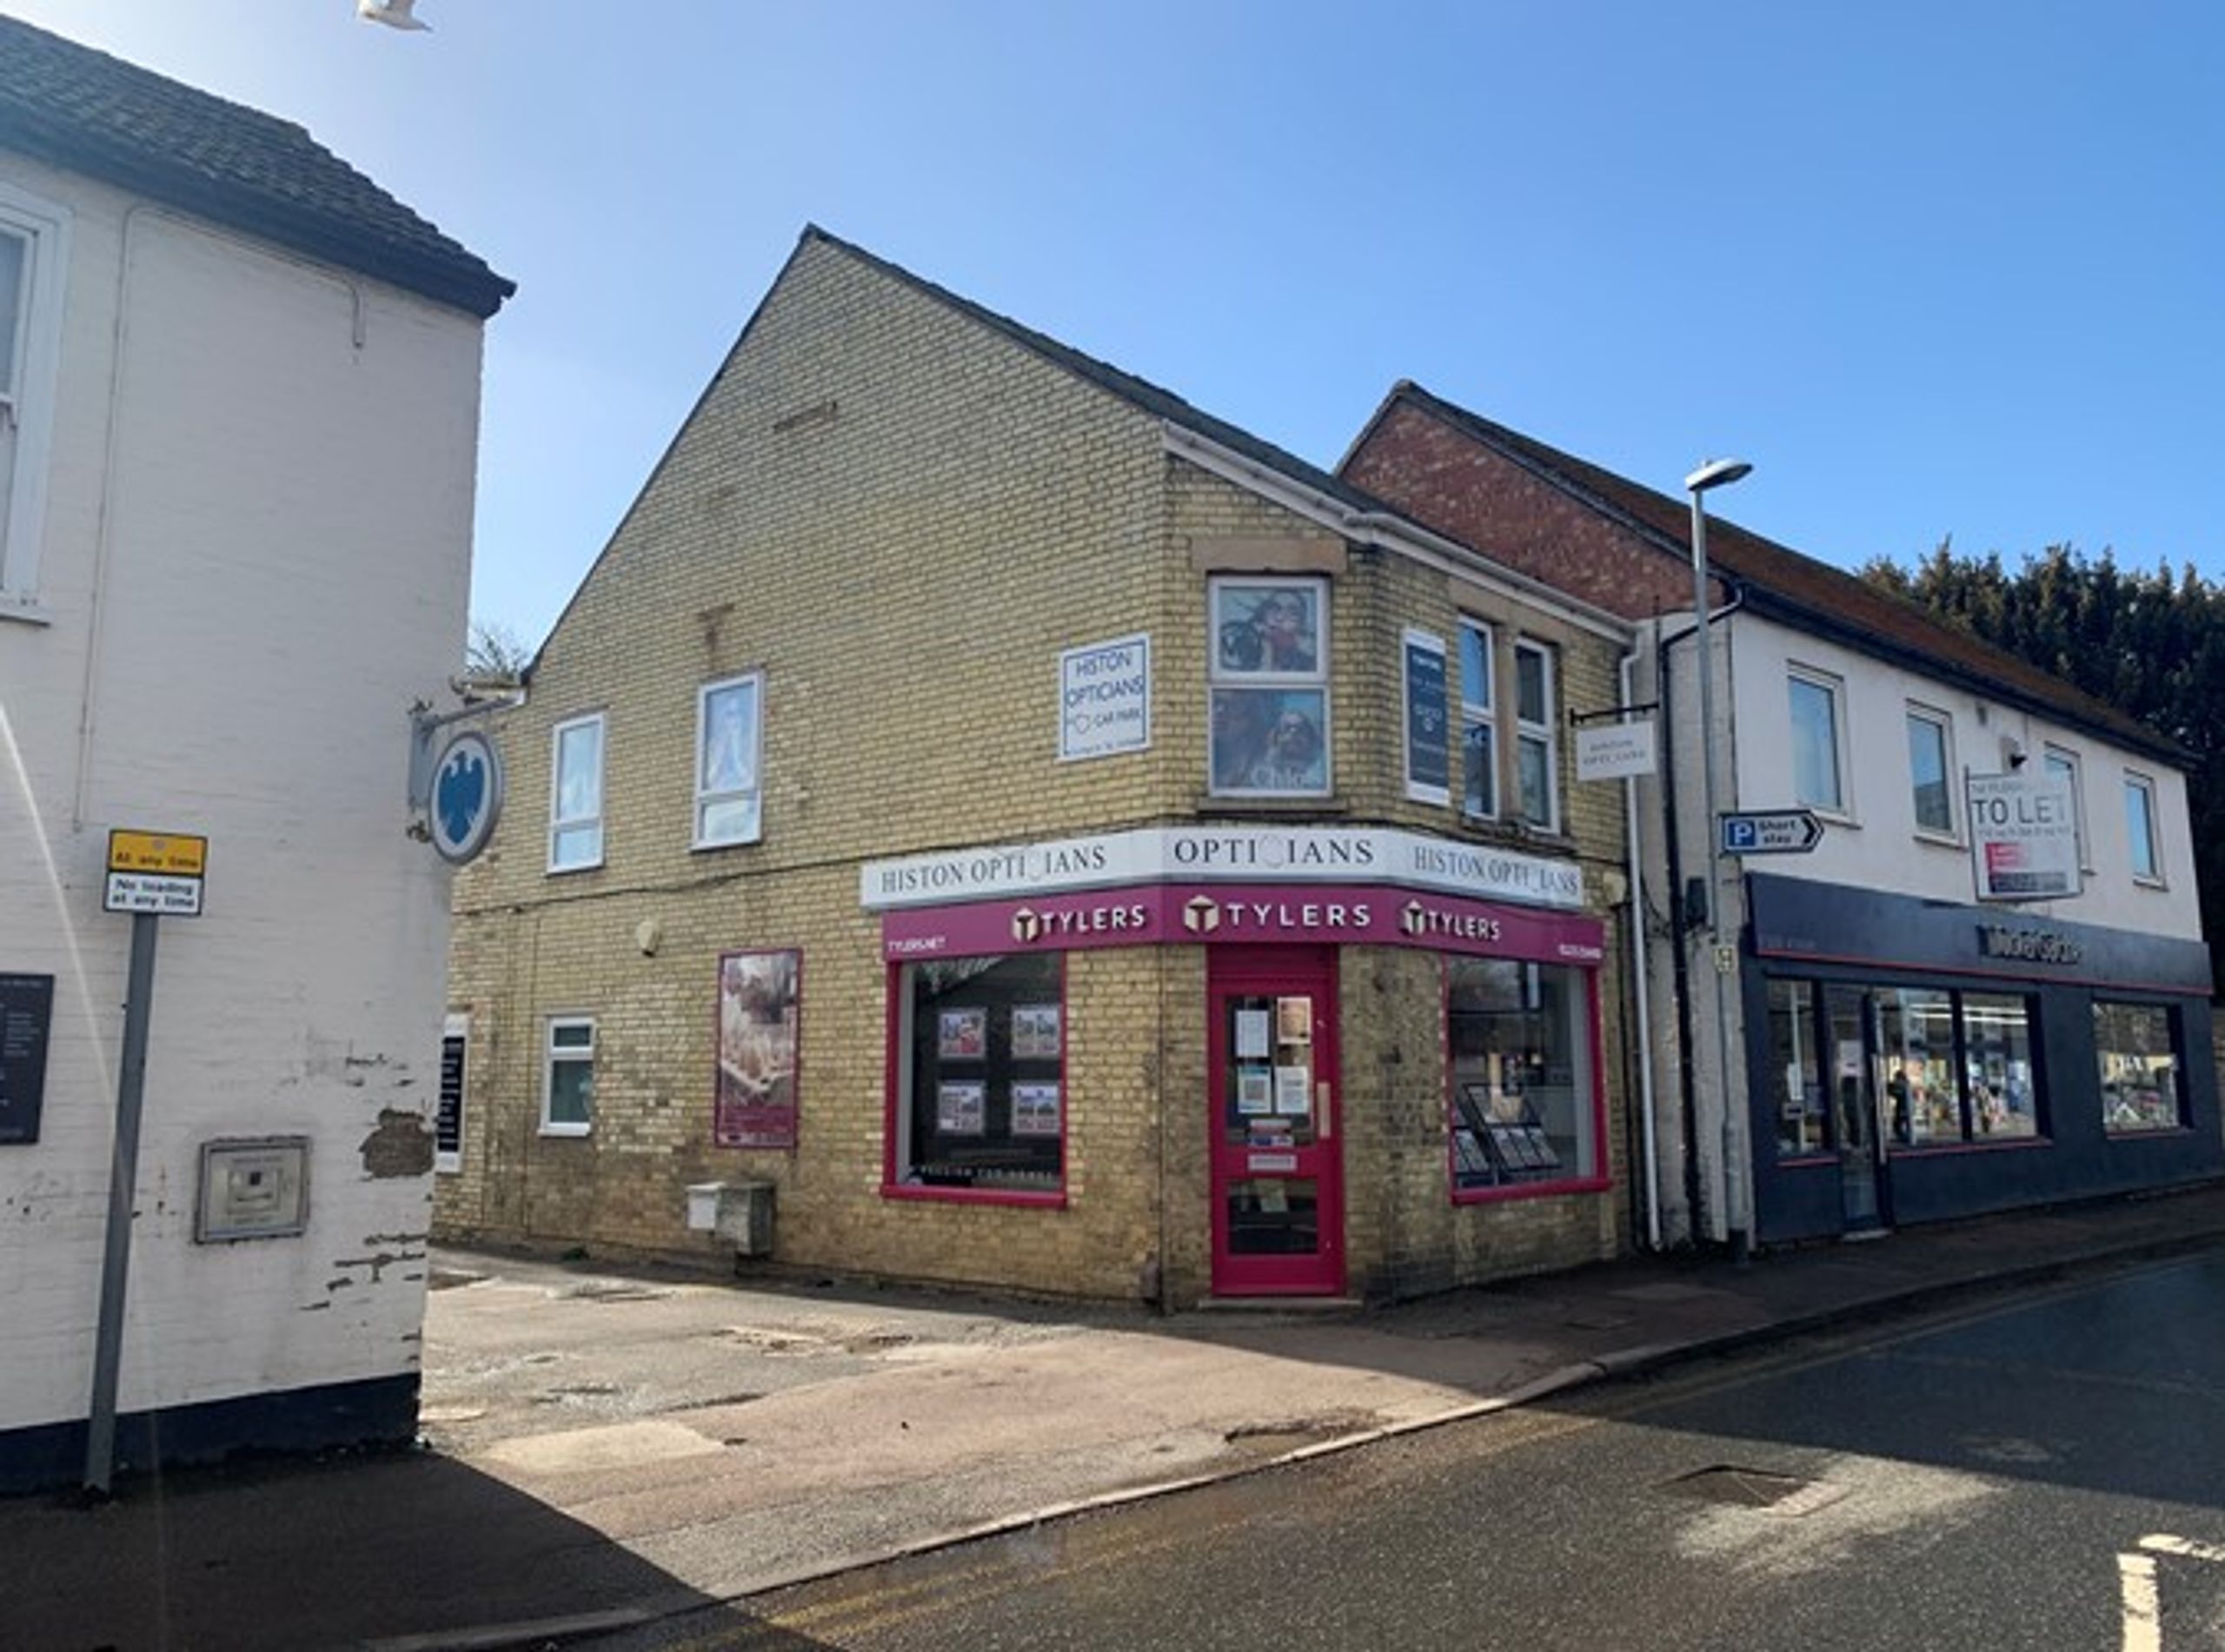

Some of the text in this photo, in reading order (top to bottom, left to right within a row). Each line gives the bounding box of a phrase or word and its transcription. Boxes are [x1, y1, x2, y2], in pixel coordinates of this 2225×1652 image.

[1972, 795, 2066, 825] TO LET
[1758, 819, 1797, 832] Short
[881, 862, 963, 893] HISTON
[1414, 846, 1577, 895] HISTON OPTIIANS
[111, 892, 195, 907] at any time
[116, 879, 193, 896] No loading
[1041, 905, 1146, 934] TYLERS
[1226, 903, 1372, 927] TYLERS
[1426, 910, 1502, 942] TYLERS
